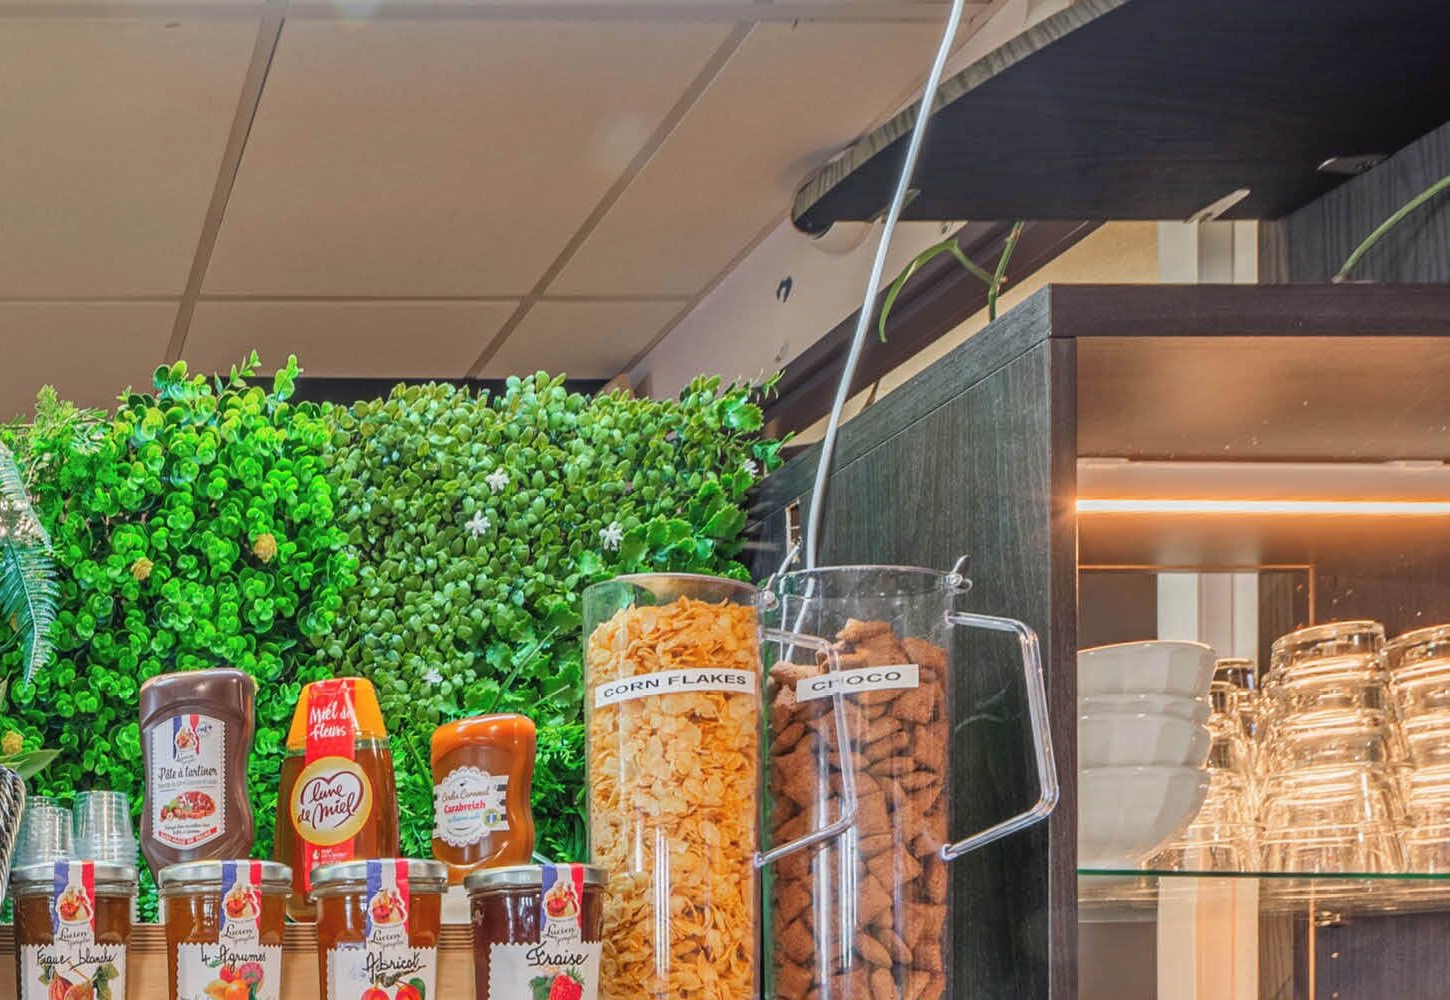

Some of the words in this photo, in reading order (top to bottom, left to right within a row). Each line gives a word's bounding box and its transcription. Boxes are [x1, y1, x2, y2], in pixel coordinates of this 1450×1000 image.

[603, 677, 661, 698] CORN
[667, 672, 748, 687] FLAKES
[811, 671, 902, 692] CHOCO
[202, 945, 211, 966] 4
[363, 951, 426, 979] Abricot
[526, 941, 589, 967] Fraise
